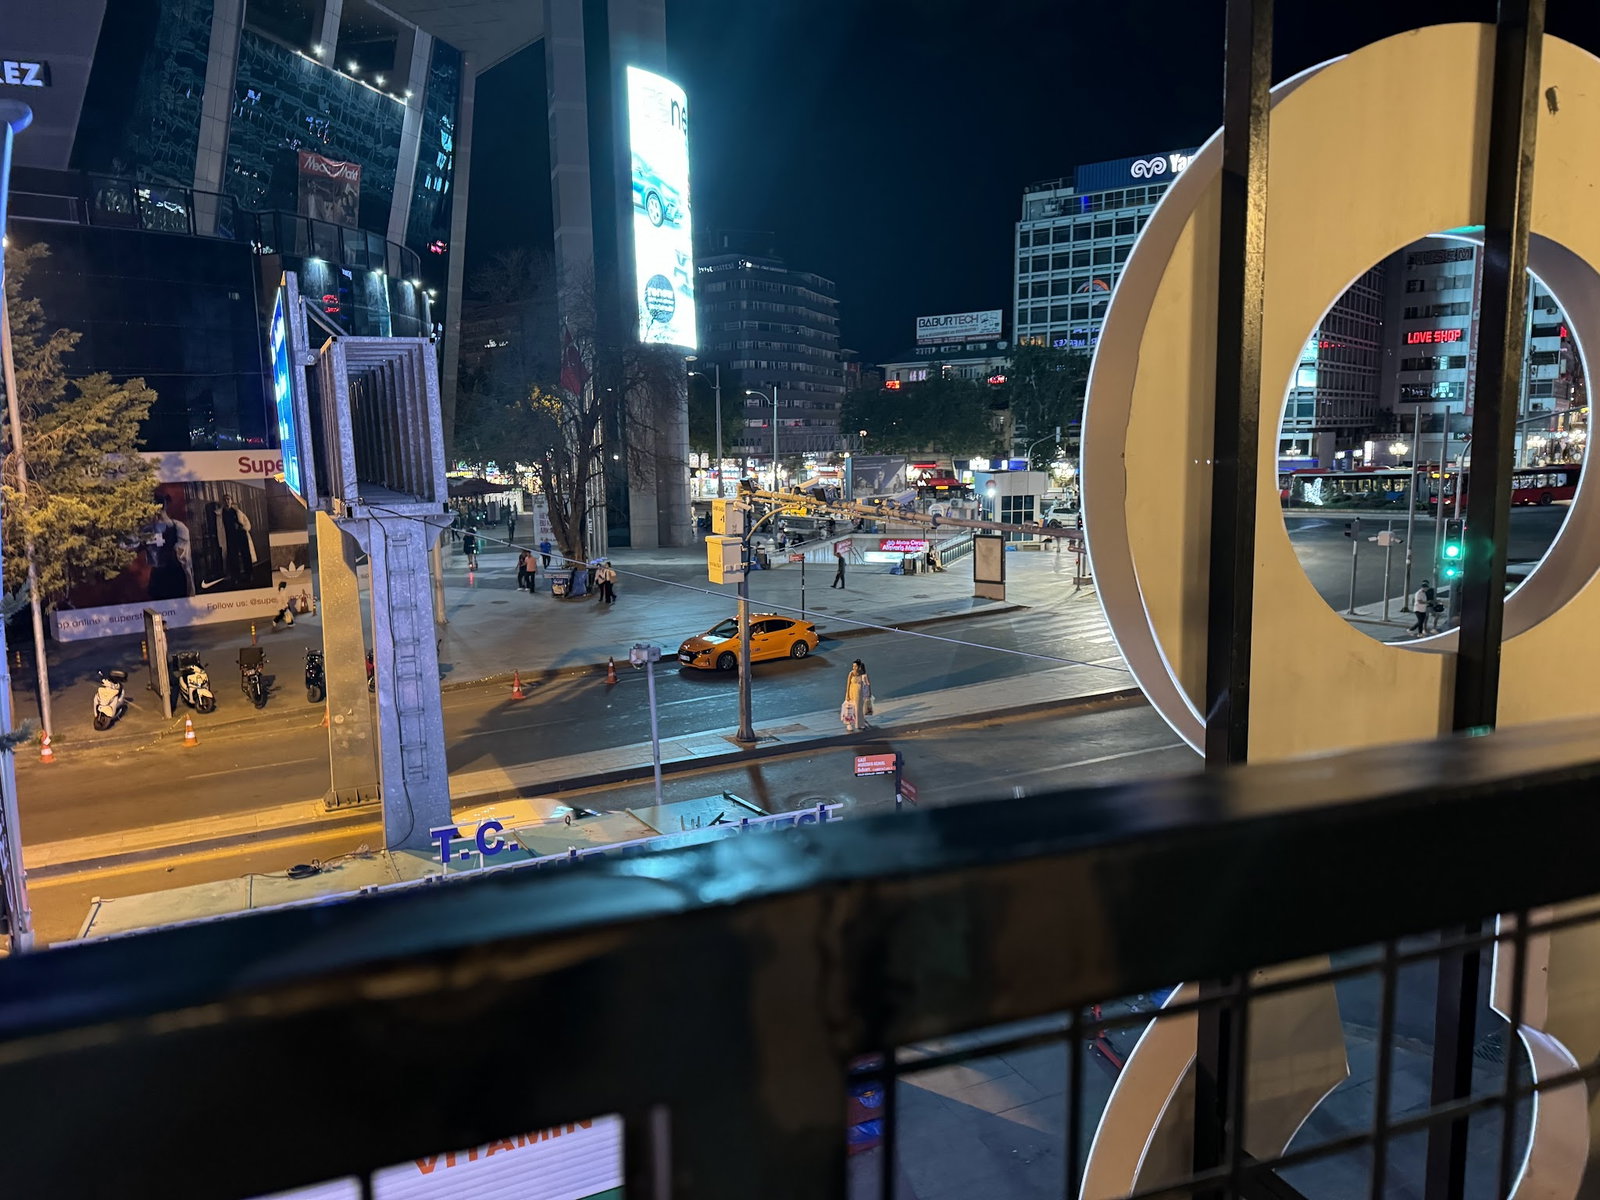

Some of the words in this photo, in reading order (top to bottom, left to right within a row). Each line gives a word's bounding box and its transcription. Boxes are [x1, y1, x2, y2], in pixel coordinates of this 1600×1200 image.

[0, 61, 44, 87] EZ
[918, 314, 979, 328] BABURTECH
[1407, 331, 1432, 345] LOVE
[1433, 328, 1462, 342] SHOP
[238, 456, 284, 477] Supe
[207, 601, 234, 611] Follow
